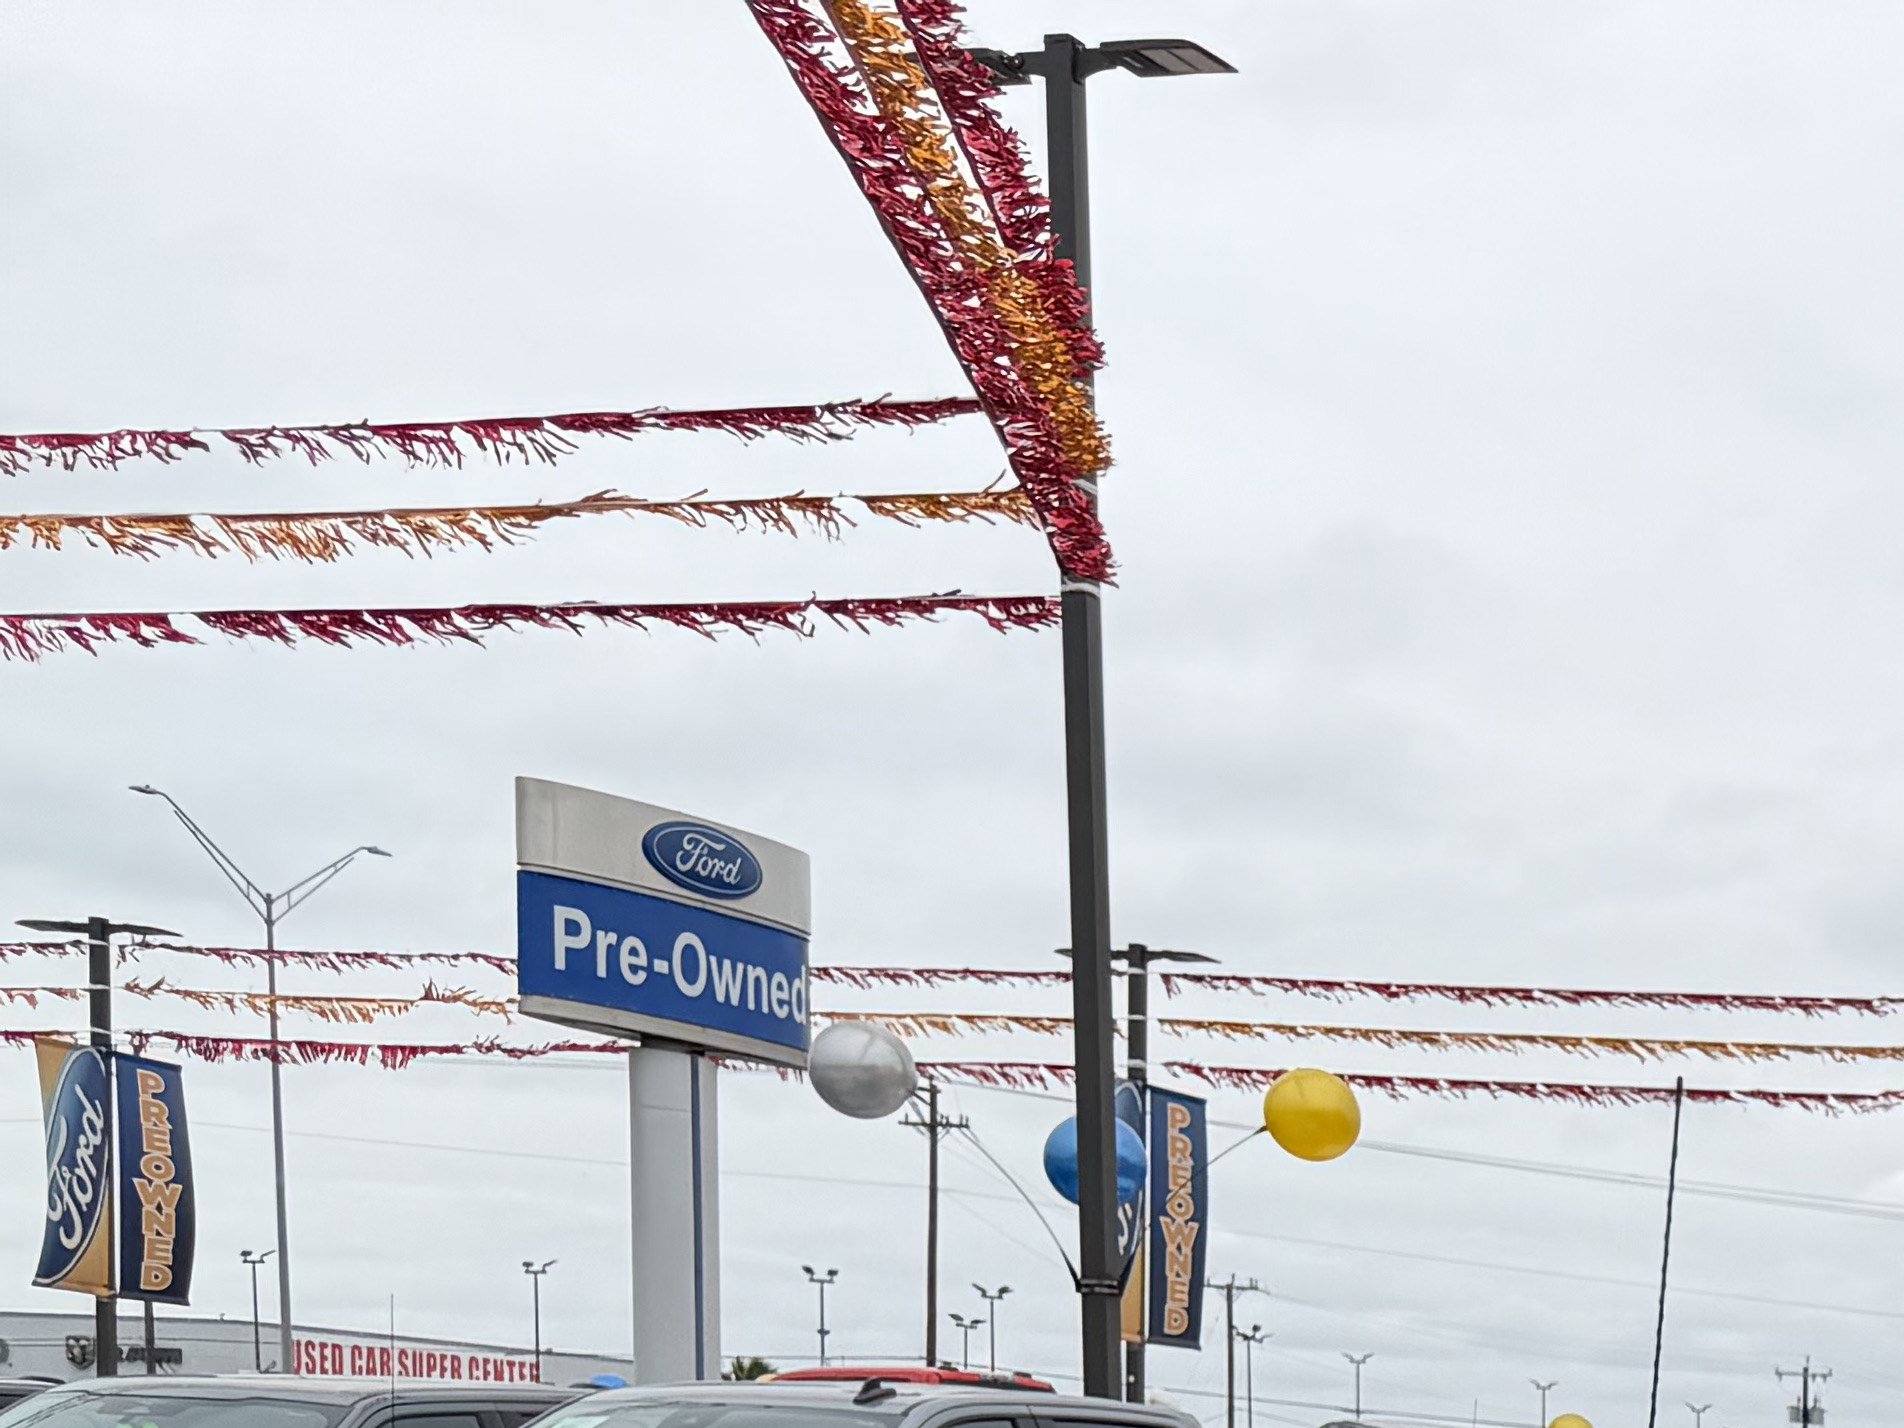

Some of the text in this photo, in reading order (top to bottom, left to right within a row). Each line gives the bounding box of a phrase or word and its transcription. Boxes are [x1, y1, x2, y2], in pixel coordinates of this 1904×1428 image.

[675, 832, 742, 886] Ford
[553, 904, 807, 1025] Pre-Owned
[47, 1083, 105, 1250] Ford
[132, 1068, 182, 1291] PREOWNED
[1159, 1102, 1199, 1335] PREOWNED
[350, 1345, 392, 1376] CAR
